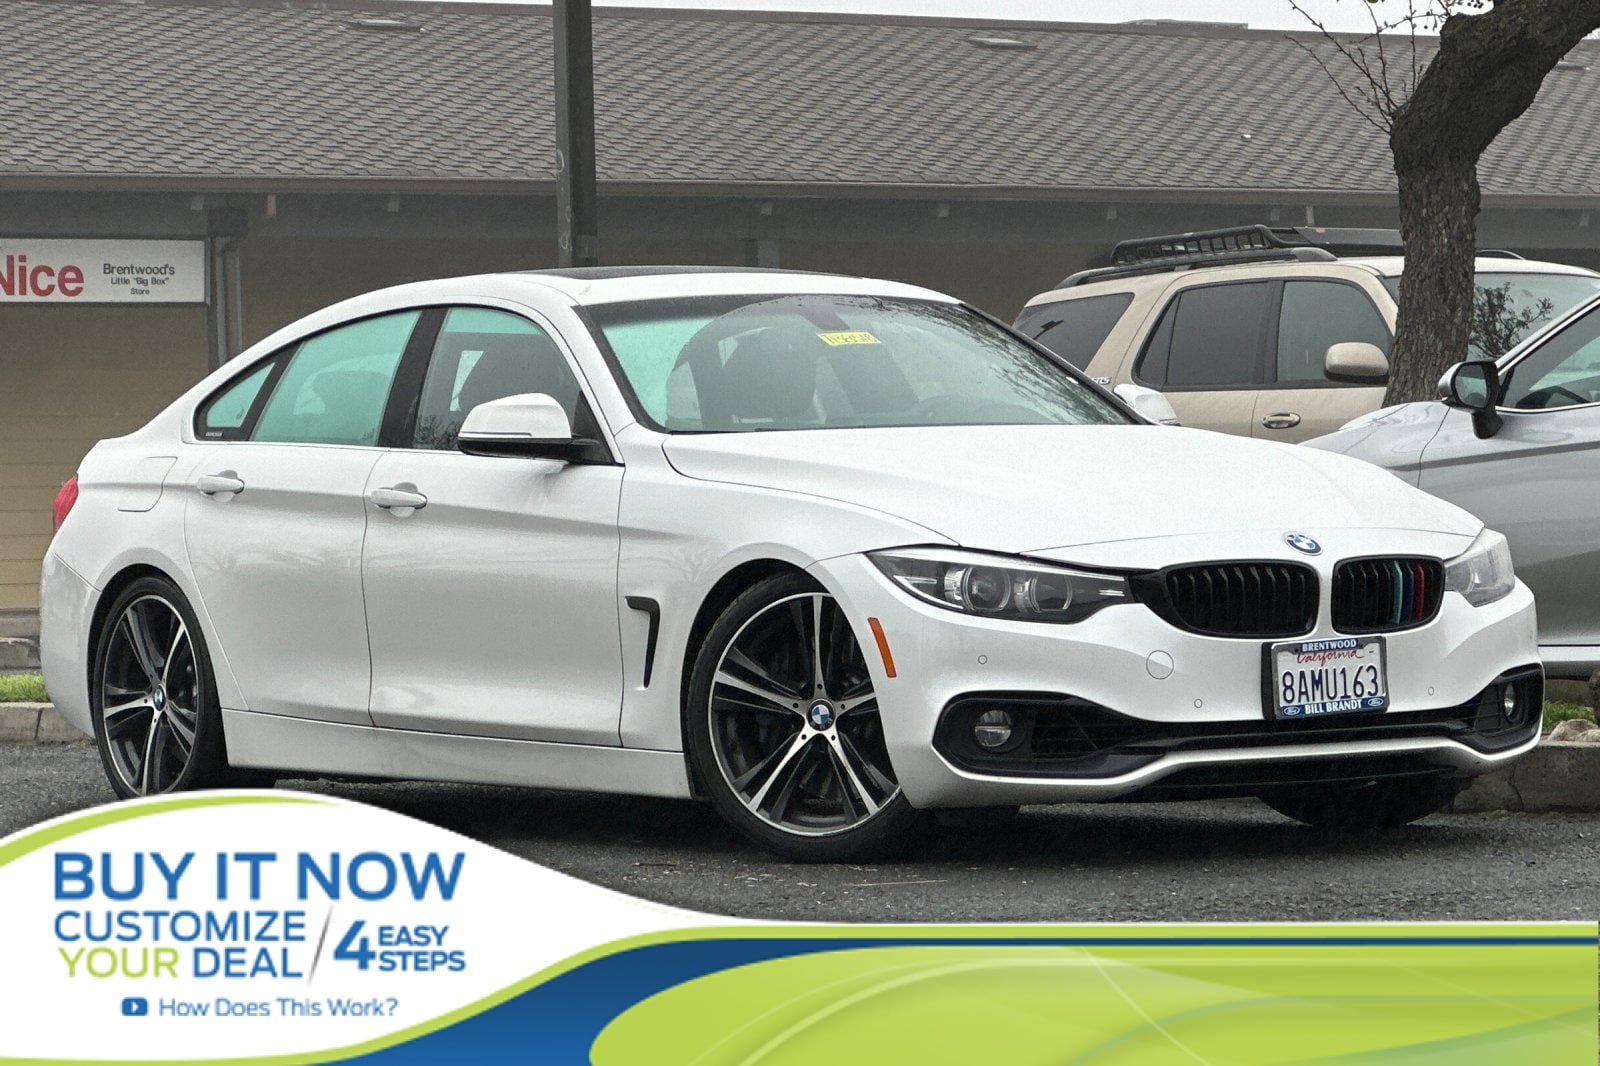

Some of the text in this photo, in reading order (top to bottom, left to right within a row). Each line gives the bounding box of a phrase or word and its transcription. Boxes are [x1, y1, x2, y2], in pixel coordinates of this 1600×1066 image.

[103, 263, 175, 275] Brentwood's
[110, 277, 130, 285] Little
[130, 287, 150, 295] Store
[1302, 639, 1357, 652] BRENTWOOD
[1296, 650, 1364, 667] California
[1282, 665, 1379, 703] 8AMU163
[1304, 703, 1323, 714] BILL
[1326, 699, 1362, 712] BRANDT
